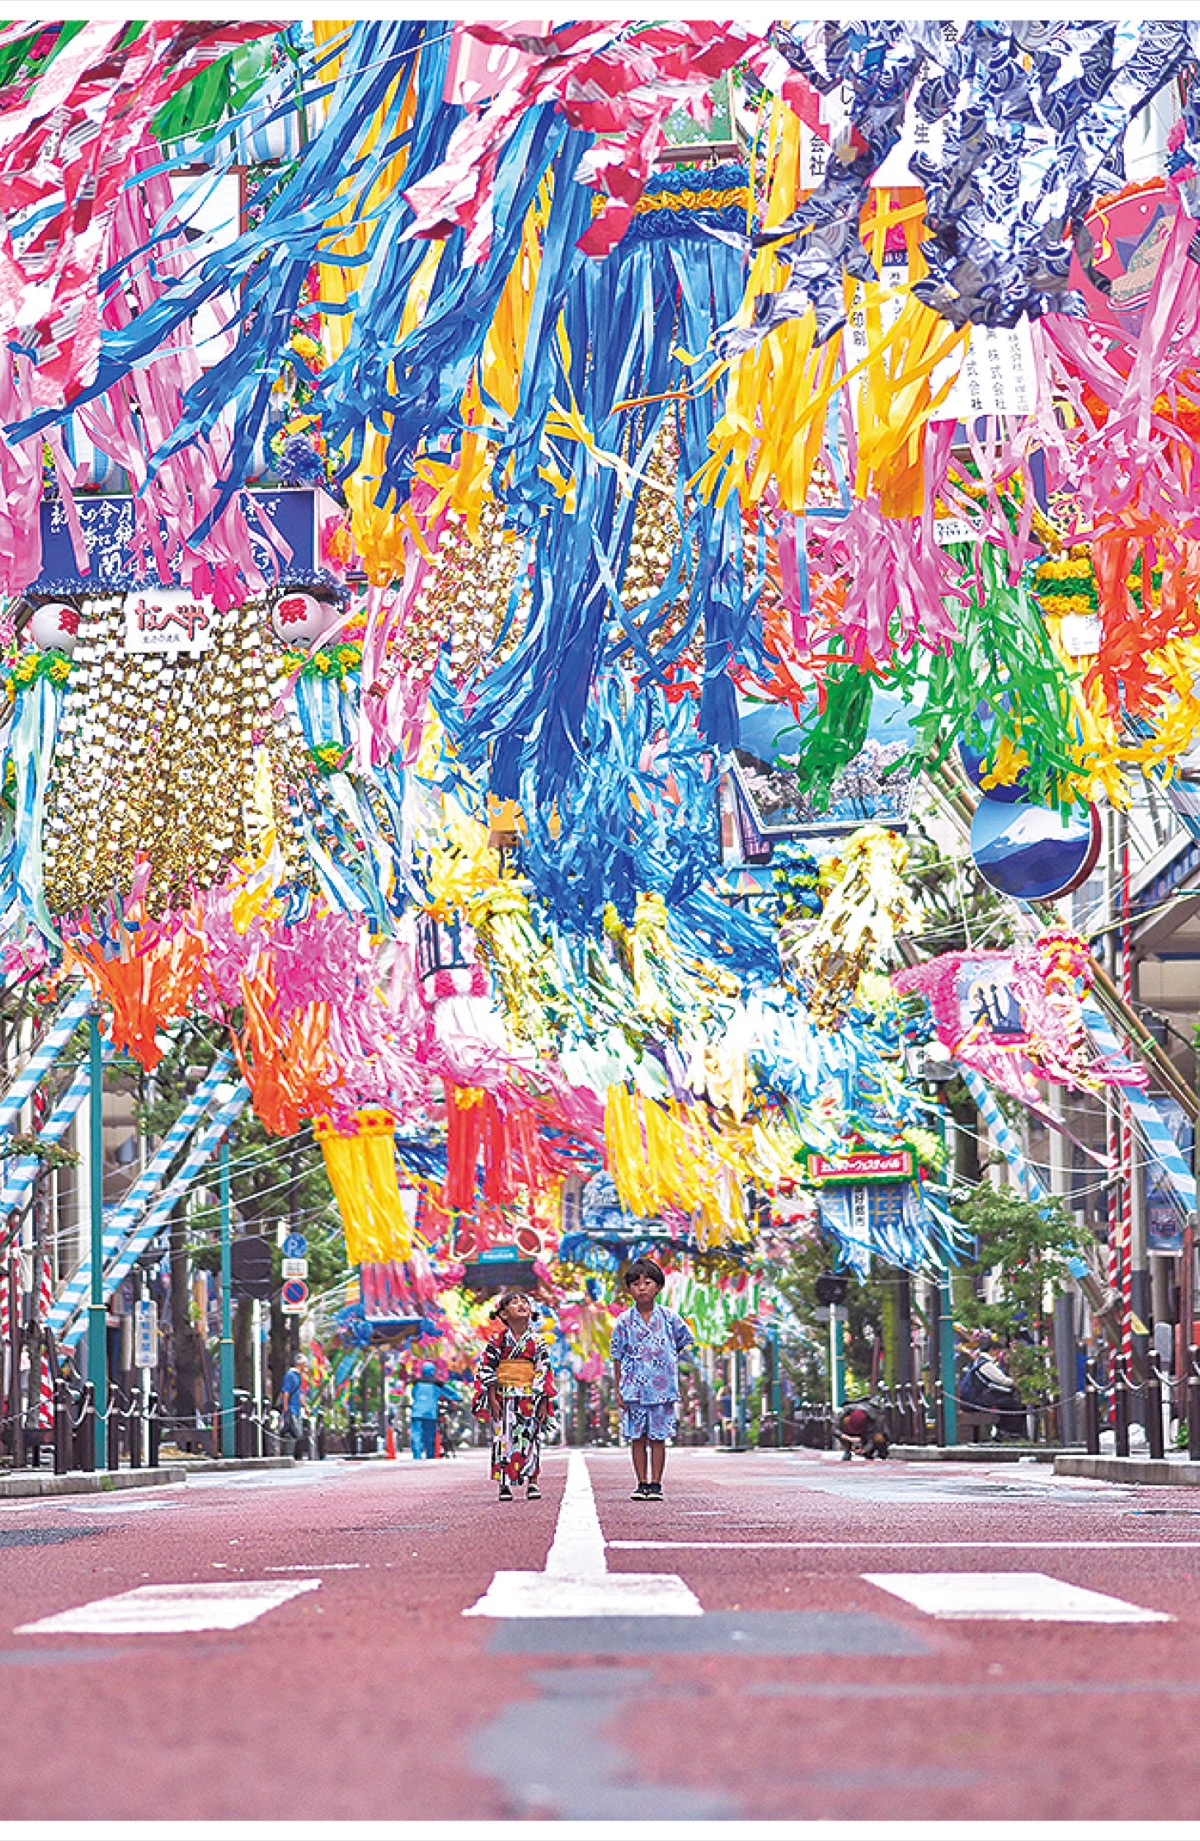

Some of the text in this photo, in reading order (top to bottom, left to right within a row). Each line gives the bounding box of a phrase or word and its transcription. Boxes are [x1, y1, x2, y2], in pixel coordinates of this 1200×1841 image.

[135, 599, 209, 641] なべや
[278, 598, 307, 626] 祭
